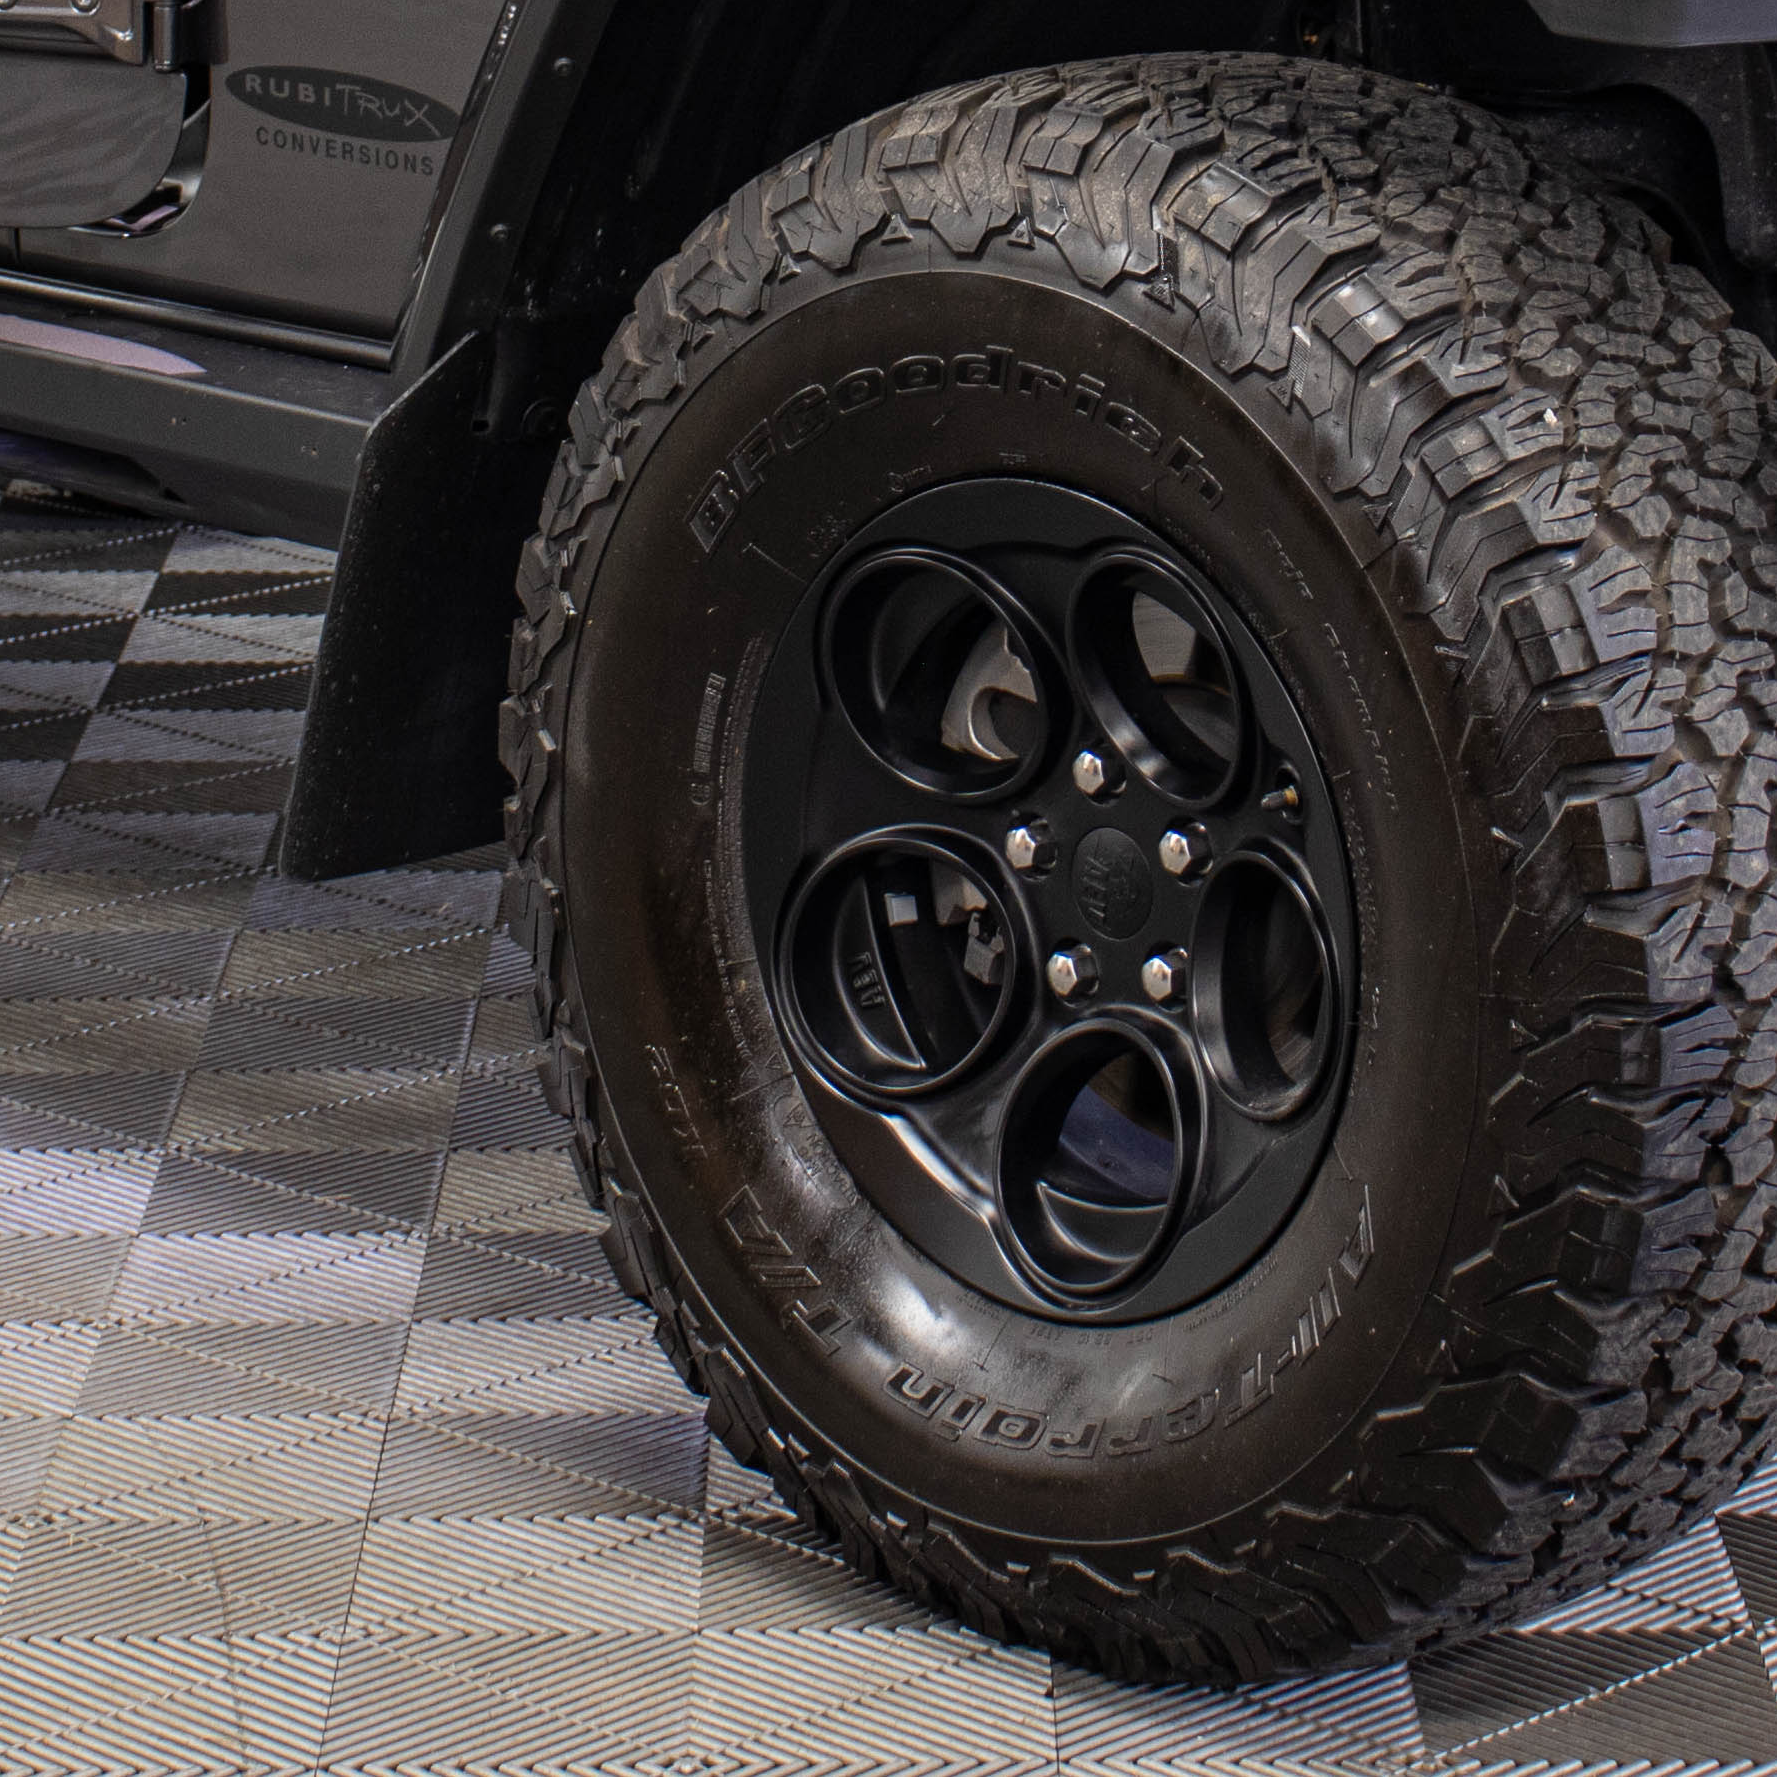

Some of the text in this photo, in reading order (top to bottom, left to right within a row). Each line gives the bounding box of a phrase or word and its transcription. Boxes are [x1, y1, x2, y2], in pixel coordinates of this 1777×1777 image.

[244, 74, 442, 138] RUBITRUX
[256, 126, 434, 175] CONVERSIONS
[684, 344, 1225, 554] BFGoodrich
